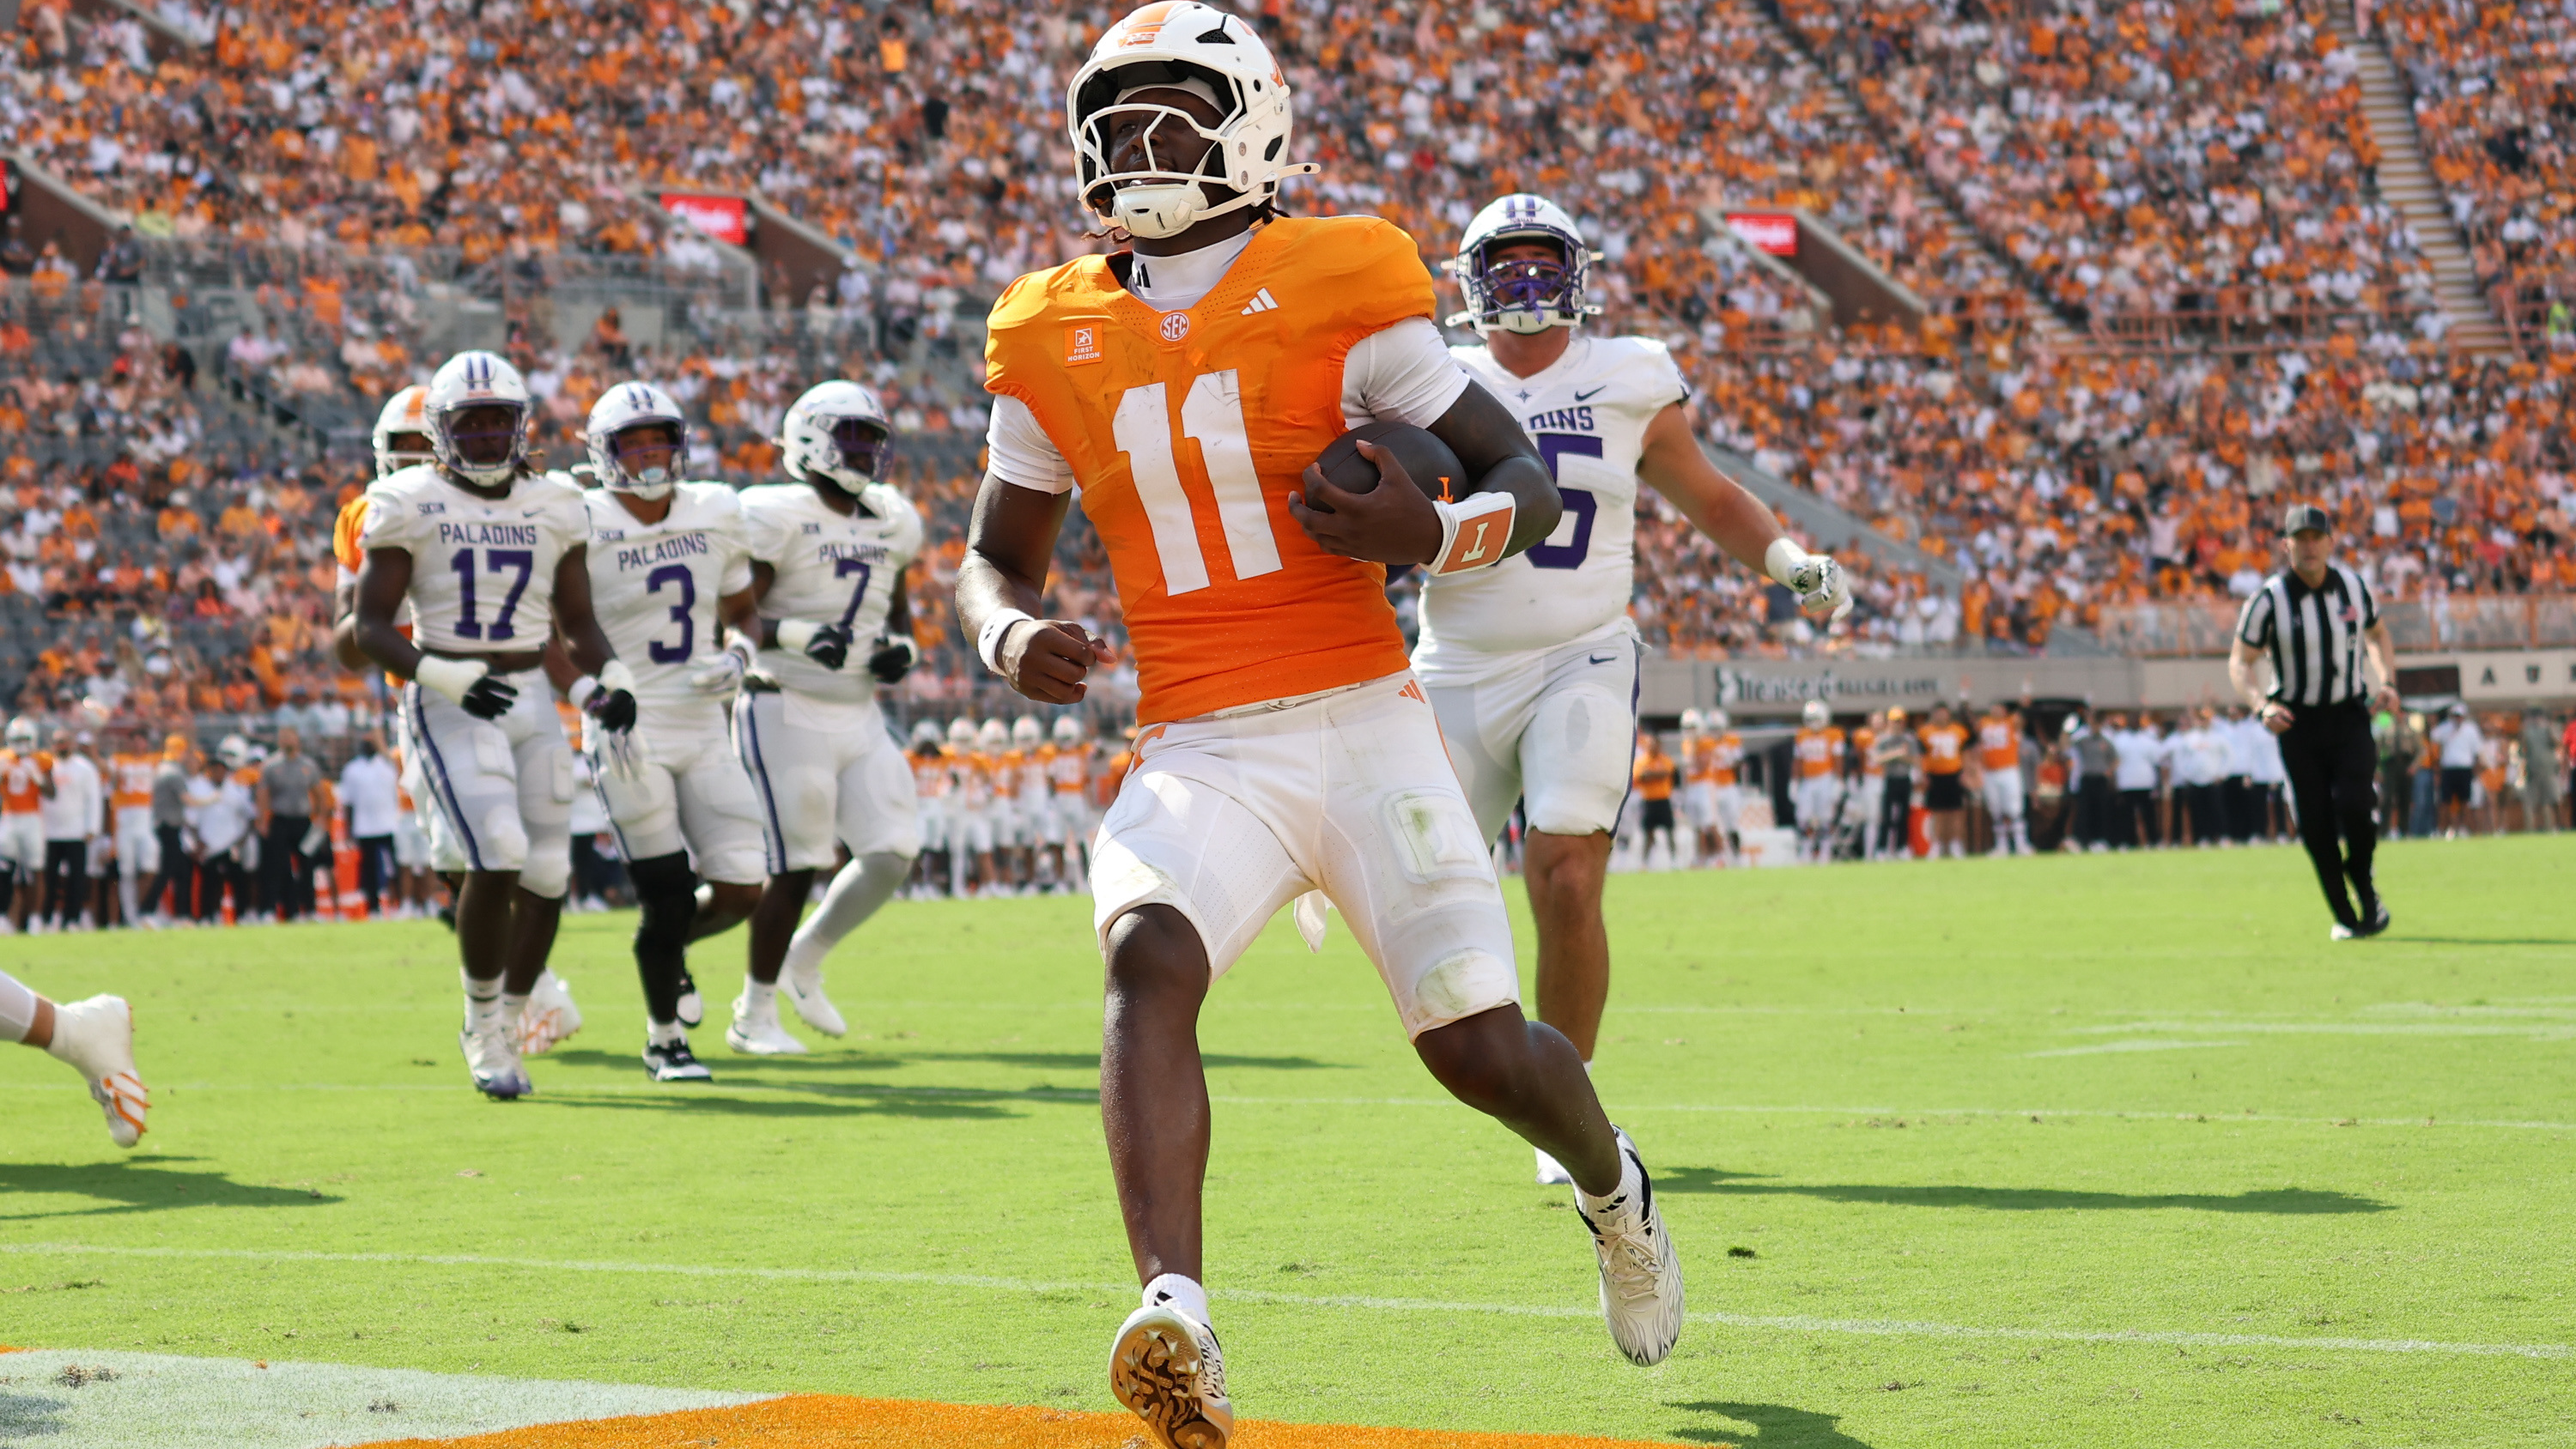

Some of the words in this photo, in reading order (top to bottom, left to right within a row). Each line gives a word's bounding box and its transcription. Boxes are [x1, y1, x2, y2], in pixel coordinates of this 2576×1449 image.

[1162, 313, 1188, 340] SEC
[1067, 352, 1101, 362] HORIZON
[1073, 346, 1094, 355] FIRST
[1529, 405, 1595, 431] DINS
[1112, 368, 1283, 597] 11
[1525, 433, 1603, 570] 5
[440, 524, 537, 545] PALADINS
[617, 532, 708, 573] PALADINS
[451, 548, 533, 640] 17
[646, 563, 696, 664] 3
[834, 558, 871, 645] 7
